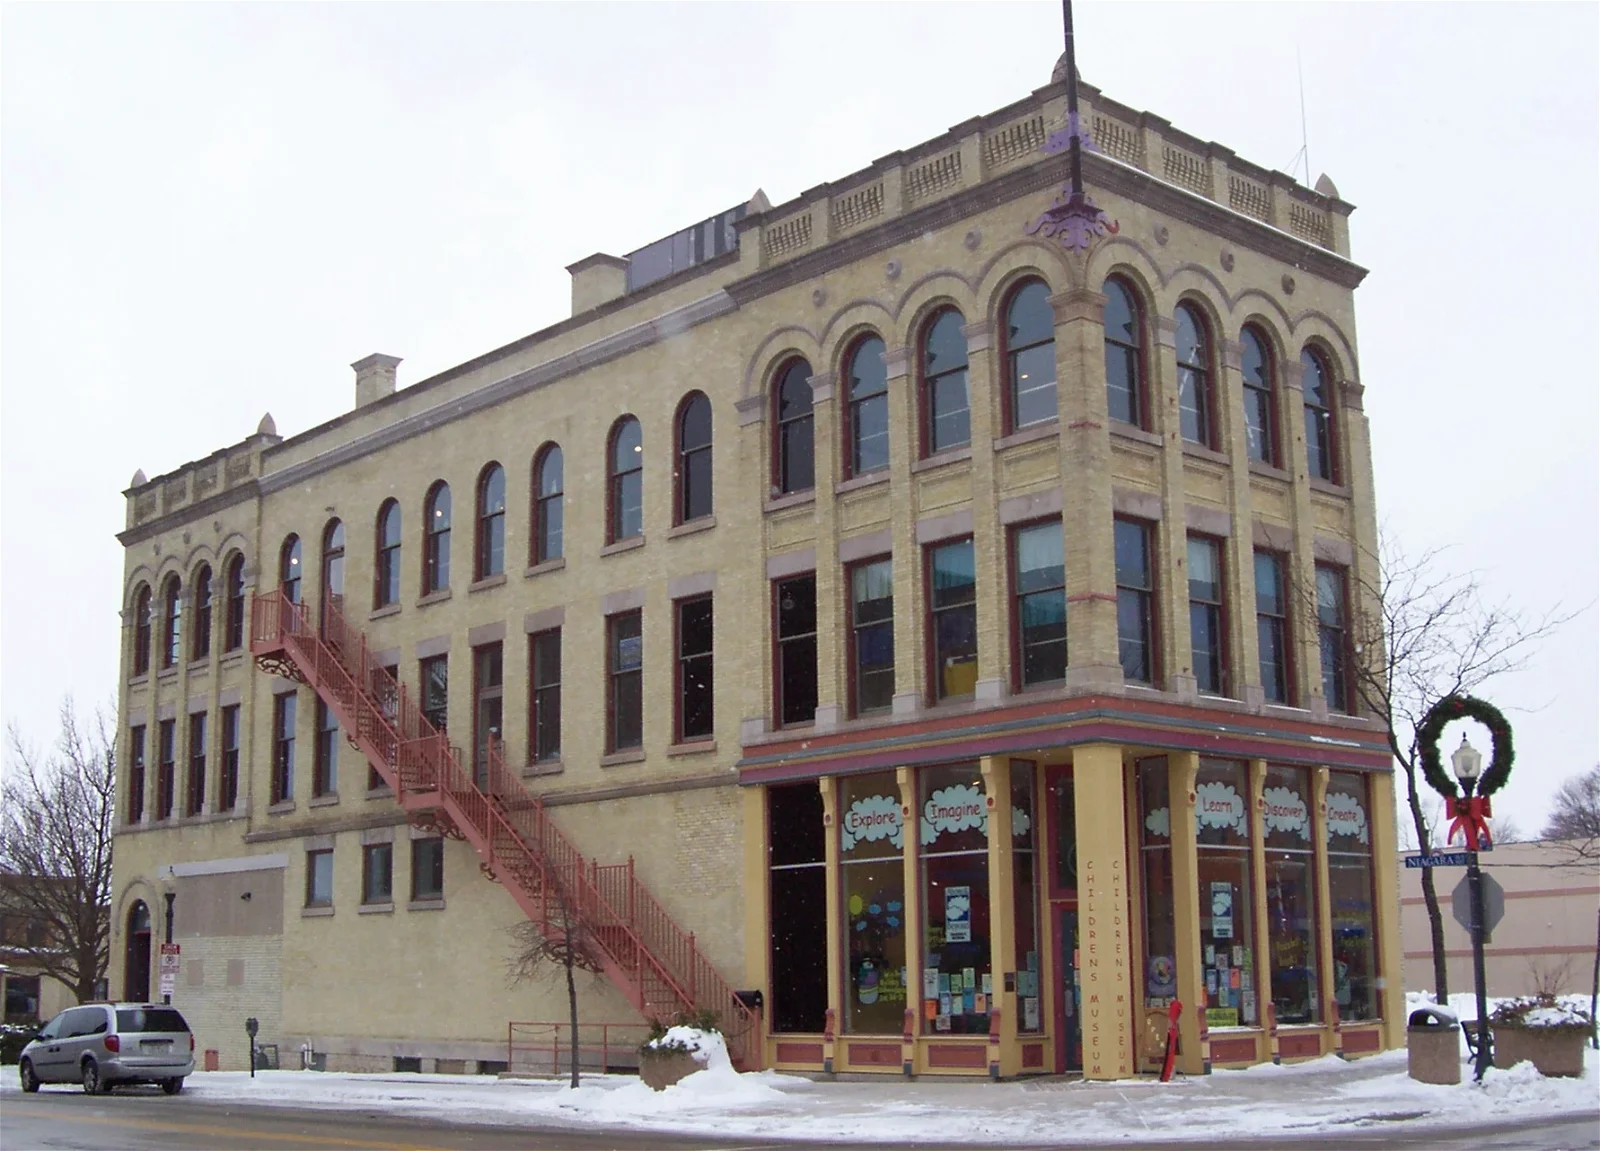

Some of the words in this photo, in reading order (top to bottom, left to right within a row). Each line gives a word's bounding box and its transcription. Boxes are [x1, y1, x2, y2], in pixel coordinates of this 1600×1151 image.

[1202, 796, 1233, 812] Learn
[1264, 804, 1304, 819] Discover
[851, 812, 896, 829] Explore
[930, 804, 981, 822] Imagine
[1328, 806, 1358, 822] Create
[1408, 855, 1454, 867] NIAGARA
[1086, 861, 1098, 982] CHILDRENS
[1112, 860, 1123, 982] CHILDRENS
[1090, 995, 1102, 1074] MUSEUM
[1116, 995, 1126, 1074] MUSEUM
